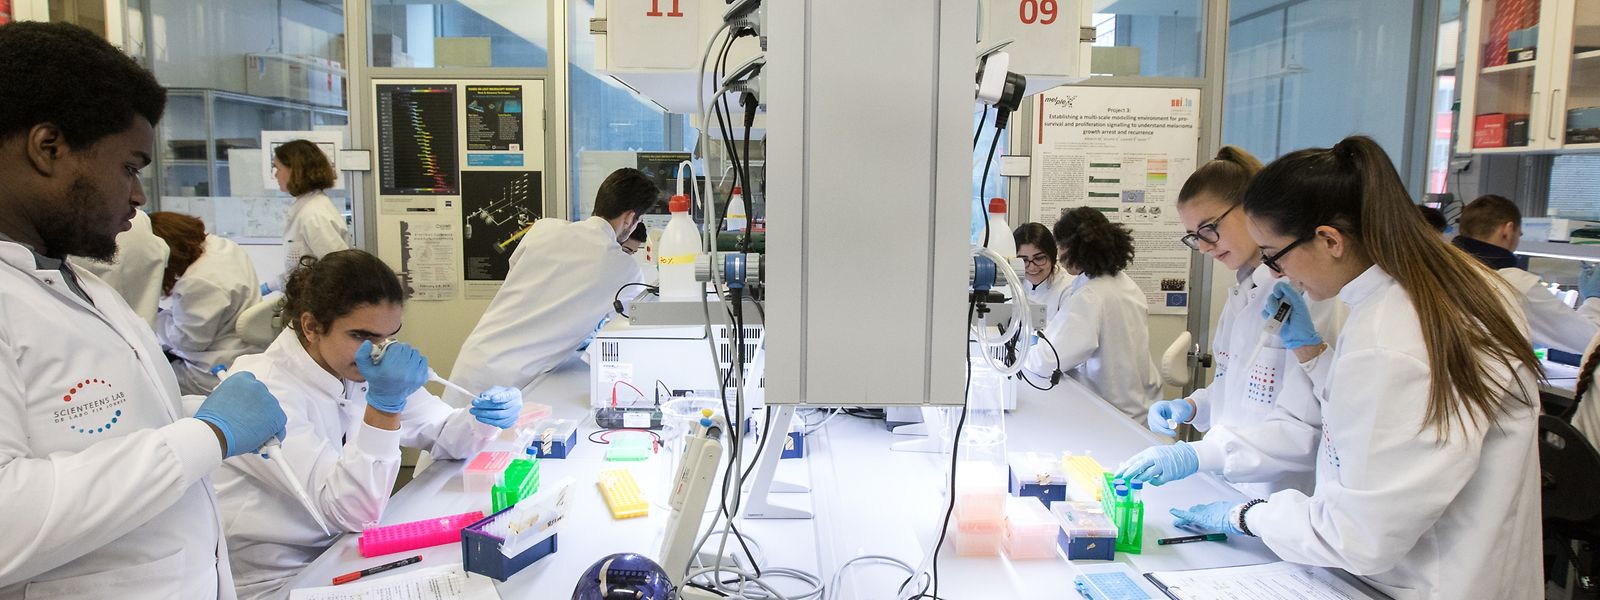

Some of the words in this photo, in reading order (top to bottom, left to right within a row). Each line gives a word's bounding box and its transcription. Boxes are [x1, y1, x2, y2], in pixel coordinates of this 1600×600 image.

[646, 0, 684, 17] 11
[1019, 0, 1058, 25] 09
[53, 397, 110, 418] SCIENTEENS
[111, 391, 125, 401] LAB
[69, 411, 88, 420] LABO
